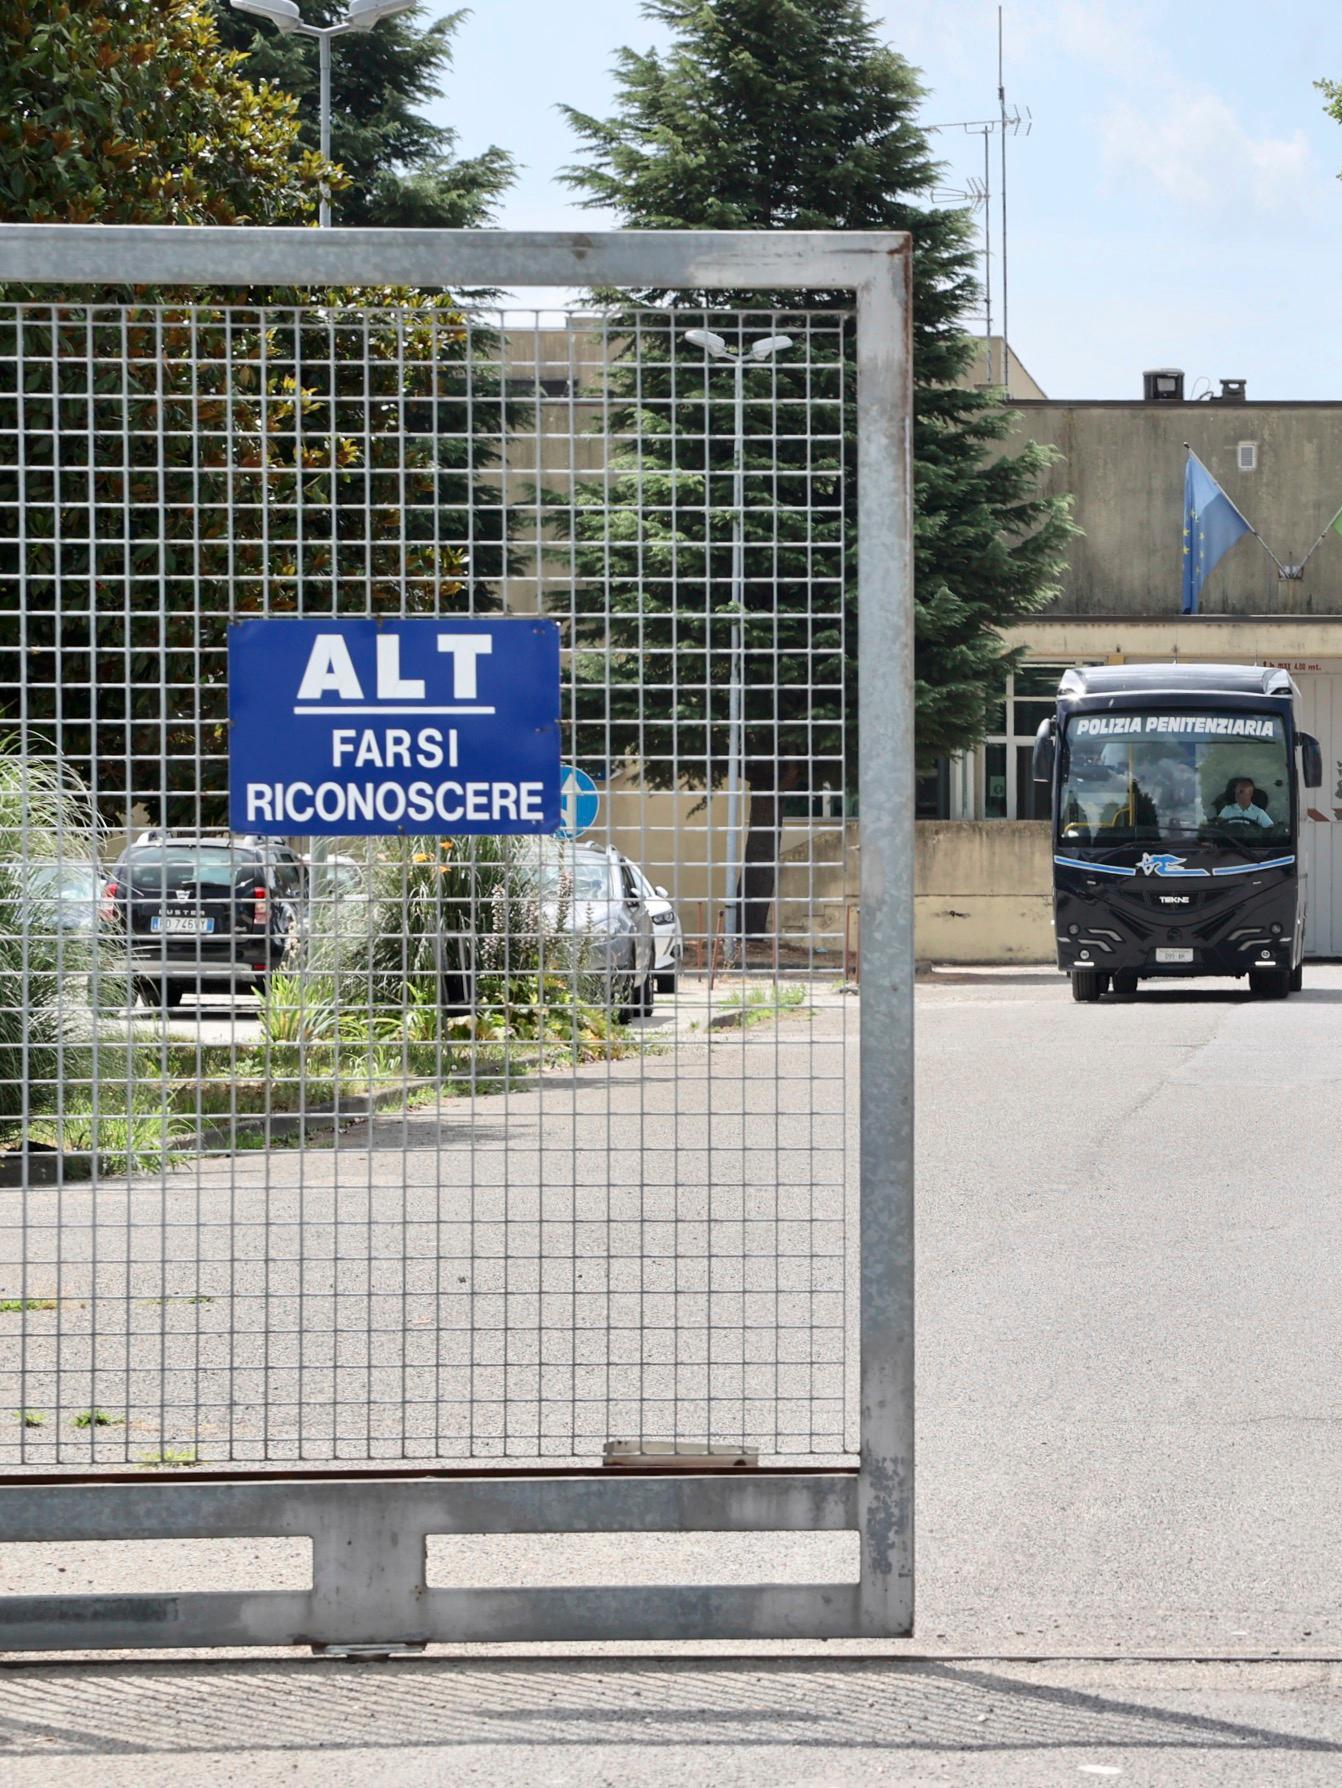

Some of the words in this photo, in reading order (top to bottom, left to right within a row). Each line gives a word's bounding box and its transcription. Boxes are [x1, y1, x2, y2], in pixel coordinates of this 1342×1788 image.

[297, 634, 492, 699] ALT
[1077, 717, 1141, 735] POLIZIA
[1146, 716, 1274, 737] PENITENZIARIA
[333, 728, 458, 768] FARSI
[247, 781, 544, 822] RICONOSCERE
[1158, 896, 1190, 904] TEKNE
